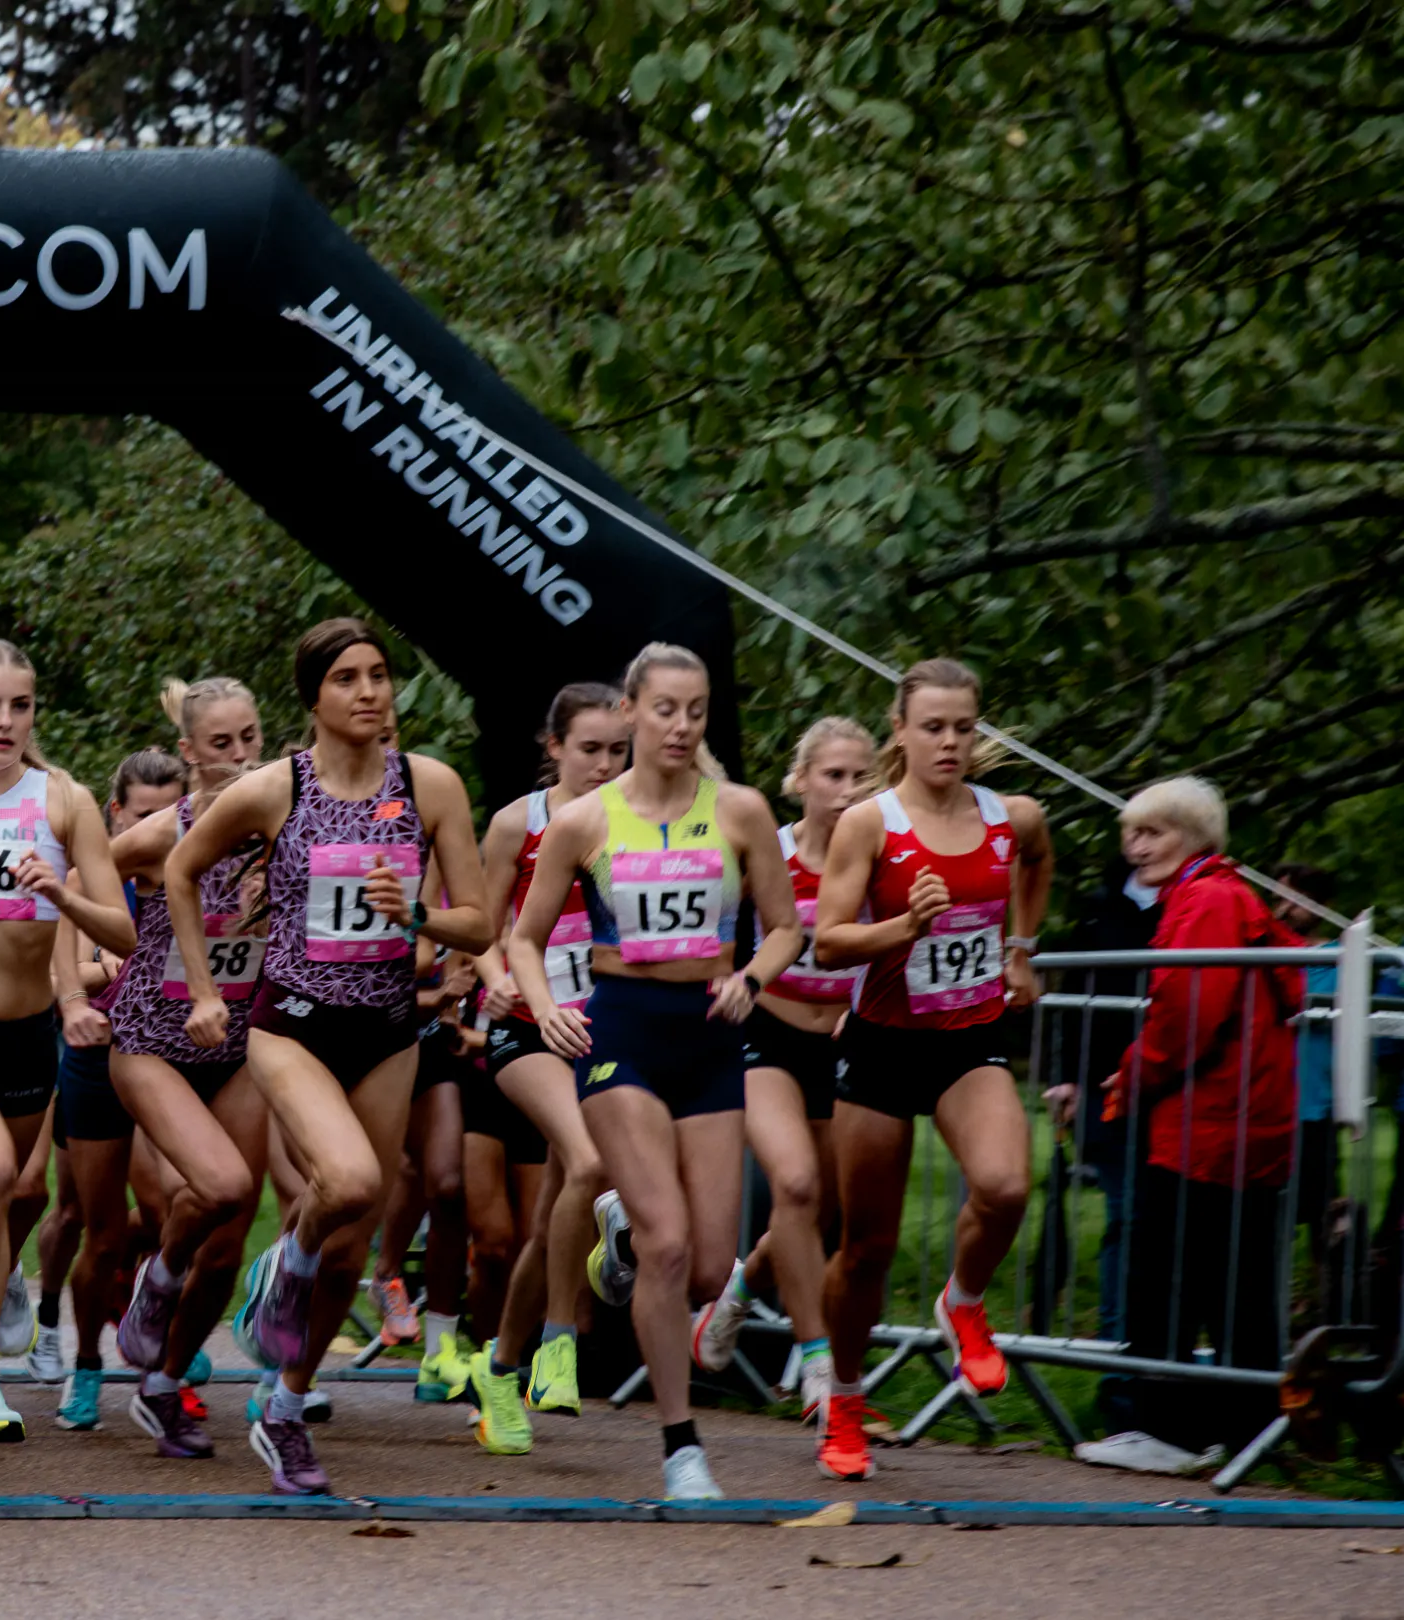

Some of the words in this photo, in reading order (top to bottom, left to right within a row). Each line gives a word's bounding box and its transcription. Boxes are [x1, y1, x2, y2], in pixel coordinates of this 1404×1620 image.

[307, 286, 589, 546] UNRIVALLED
[308, 366, 385, 432] IN
[370, 424, 593, 626] RUNNING
[332, 886, 394, 931] 15
[638, 890, 706, 932] 155
[207, 941, 251, 977] 58
[929, 936, 987, 984] 192
